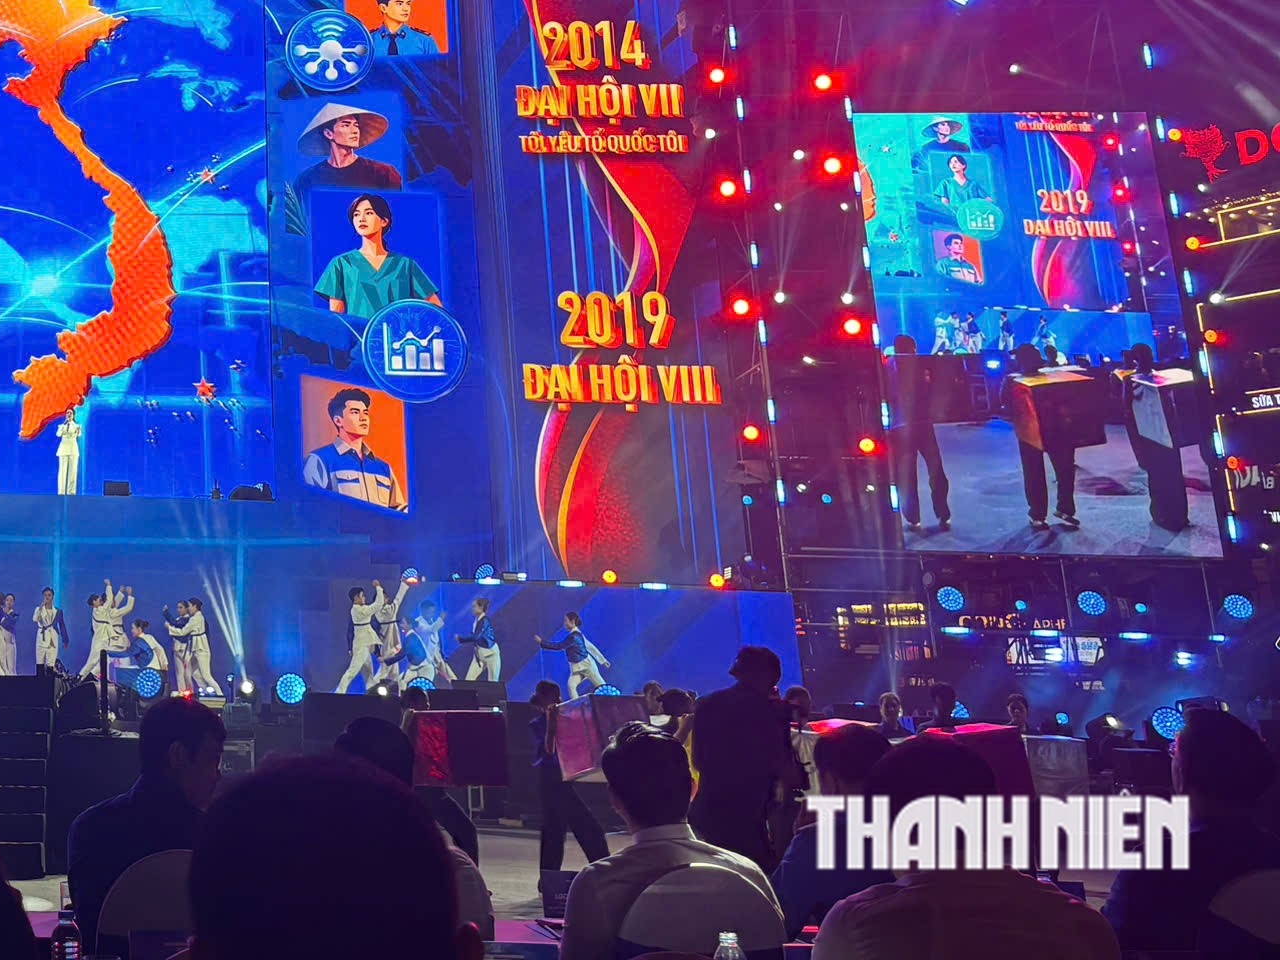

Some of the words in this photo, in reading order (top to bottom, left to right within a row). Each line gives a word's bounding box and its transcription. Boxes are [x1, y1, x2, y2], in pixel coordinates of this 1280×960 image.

[542, 20, 652, 70] 2014
[515, 85, 573, 126] ĐẠI
[577, 75, 636, 125] HỘI
[638, 84, 685, 118] VII
[519, 131, 546, 153] TÔI
[582, 127, 606, 152] TỔ
[607, 127, 655, 154] QUỐC
[657, 130, 688, 152] TÔI
[1037, 189, 1093, 214] 2019
[1084, 221, 1116, 238] VIII
[558, 291, 676, 348] 2019
[522, 363, 587, 412] ĐẠI
[589, 355, 657, 412] HỘI
[657, 365, 721, 404] VIII
